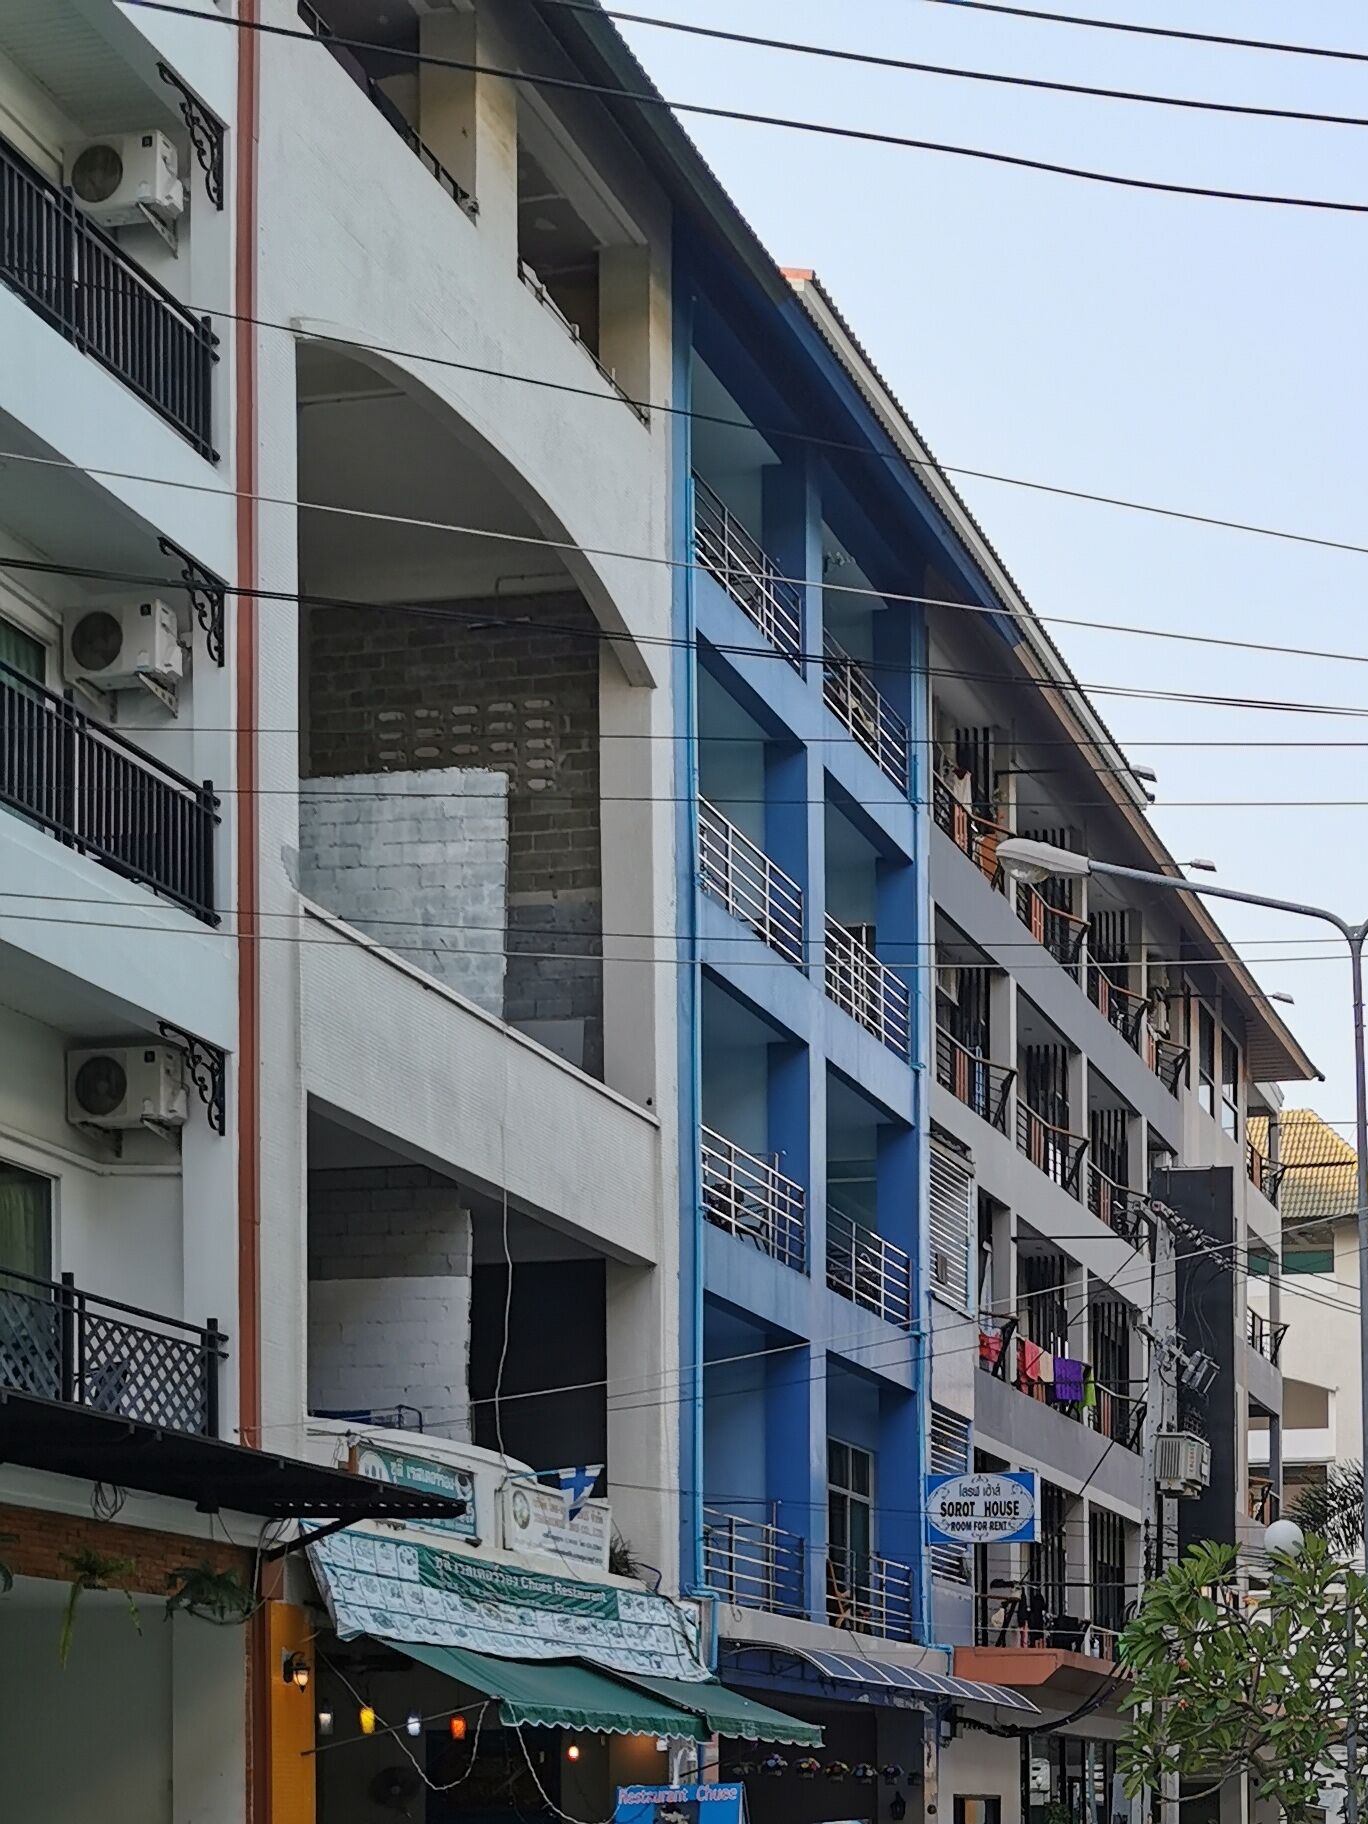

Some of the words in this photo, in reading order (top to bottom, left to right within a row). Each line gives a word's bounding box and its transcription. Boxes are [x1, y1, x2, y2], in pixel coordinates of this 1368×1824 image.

[940, 1501, 975, 1517] SOROT
[984, 1500, 1019, 1517] HOUSE
[951, 1522, 971, 1531] ROOM
[974, 1521, 988, 1531] FOR
[990, 1521, 1008, 1531] RENT
[554, 1582, 608, 1602] Restaurant
[696, 1784, 737, 1801] Chuee
